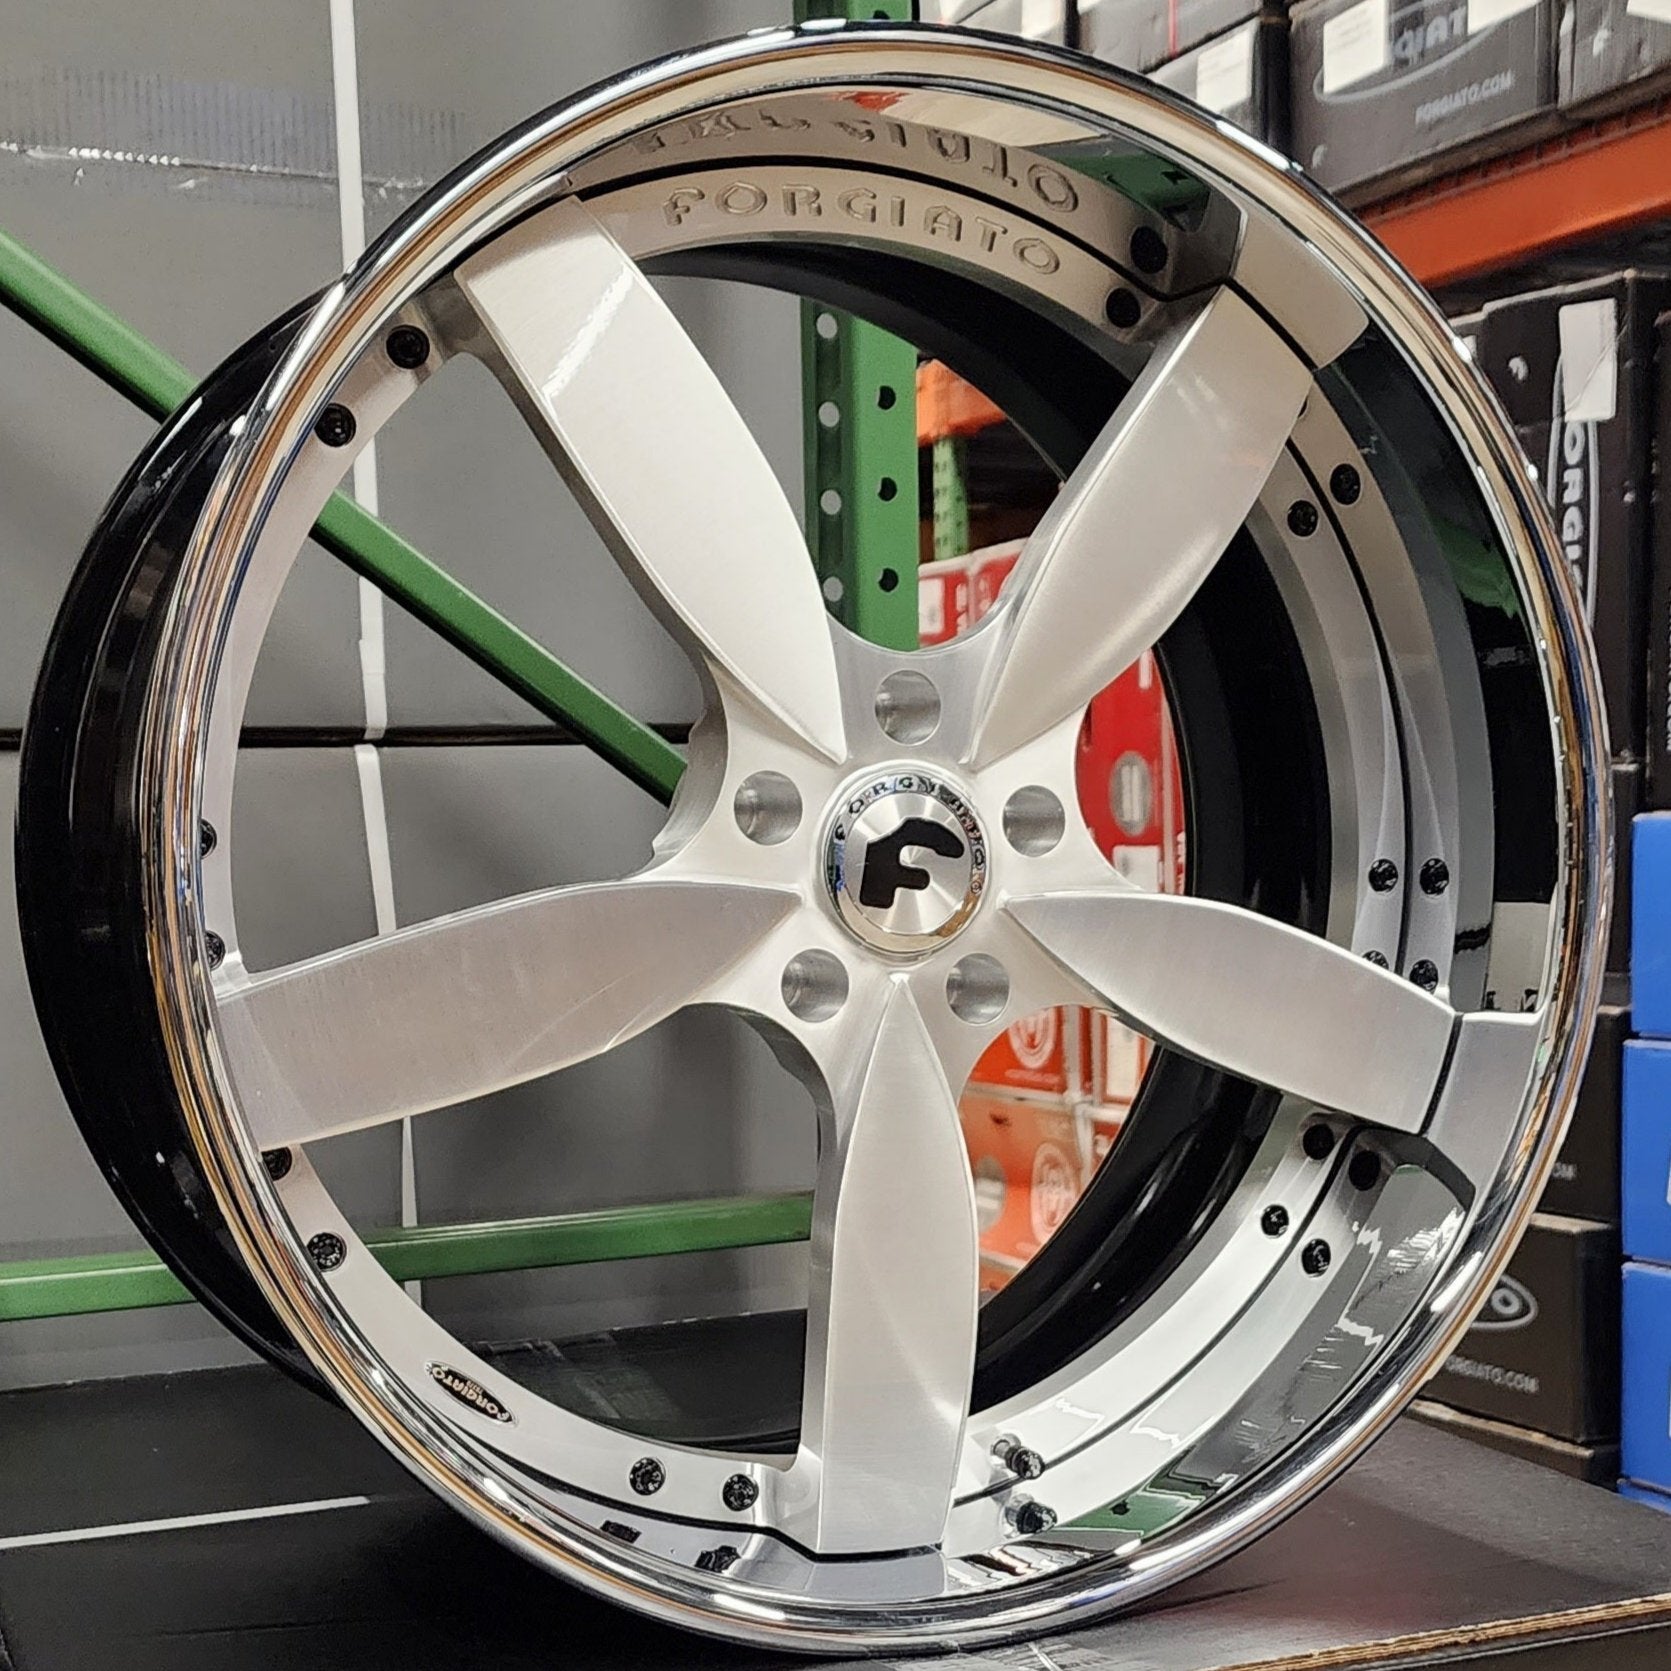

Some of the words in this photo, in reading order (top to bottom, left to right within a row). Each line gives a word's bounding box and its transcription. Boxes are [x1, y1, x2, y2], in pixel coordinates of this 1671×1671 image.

[662, 181, 1060, 275] FORGIATO
[432, 1367, 510, 1421] FORGIATO
[1446, 1355, 1540, 1393] ORGIATO.COM
